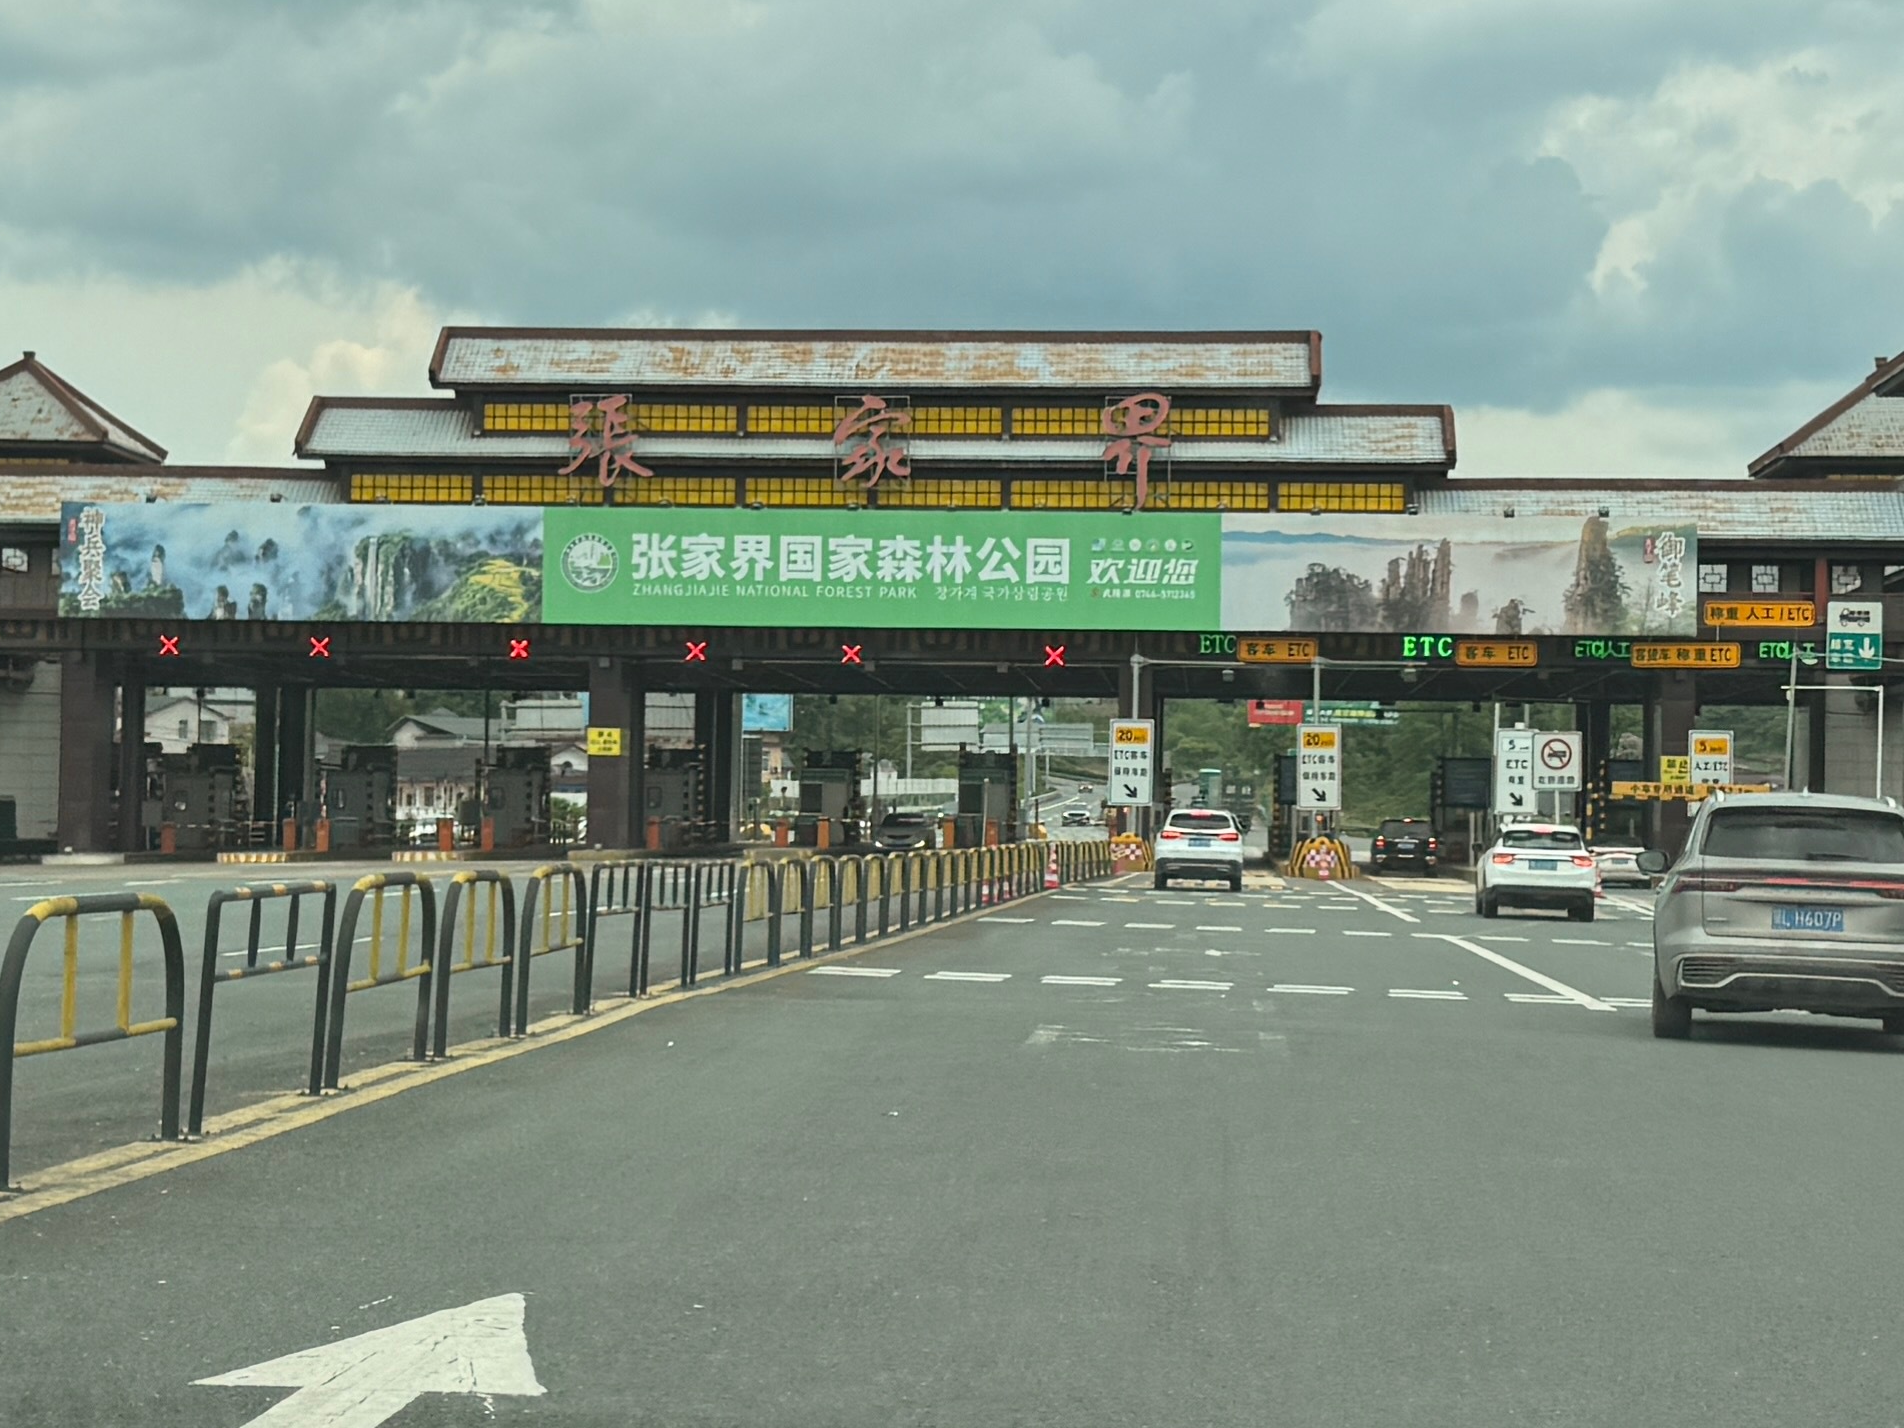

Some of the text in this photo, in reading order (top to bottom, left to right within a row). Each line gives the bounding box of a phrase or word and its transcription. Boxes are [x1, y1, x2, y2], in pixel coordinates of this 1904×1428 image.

[630, 532, 1070, 585] 张家界国家森林公园
[1086, 558, 1199, 586] 欢迎您
[632, 583, 918, 600] ZHANGJIAJIE NATIONAL FOREST PARK
[1199, 634, 1236, 654] ETC
[1288, 642, 1310, 657] ETC
[1403, 635, 1453, 657] ETC
[1507, 646, 1529, 660] ETC
[1710, 647, 1732, 662] ETC
[1506, 759, 1529, 770] ETC
